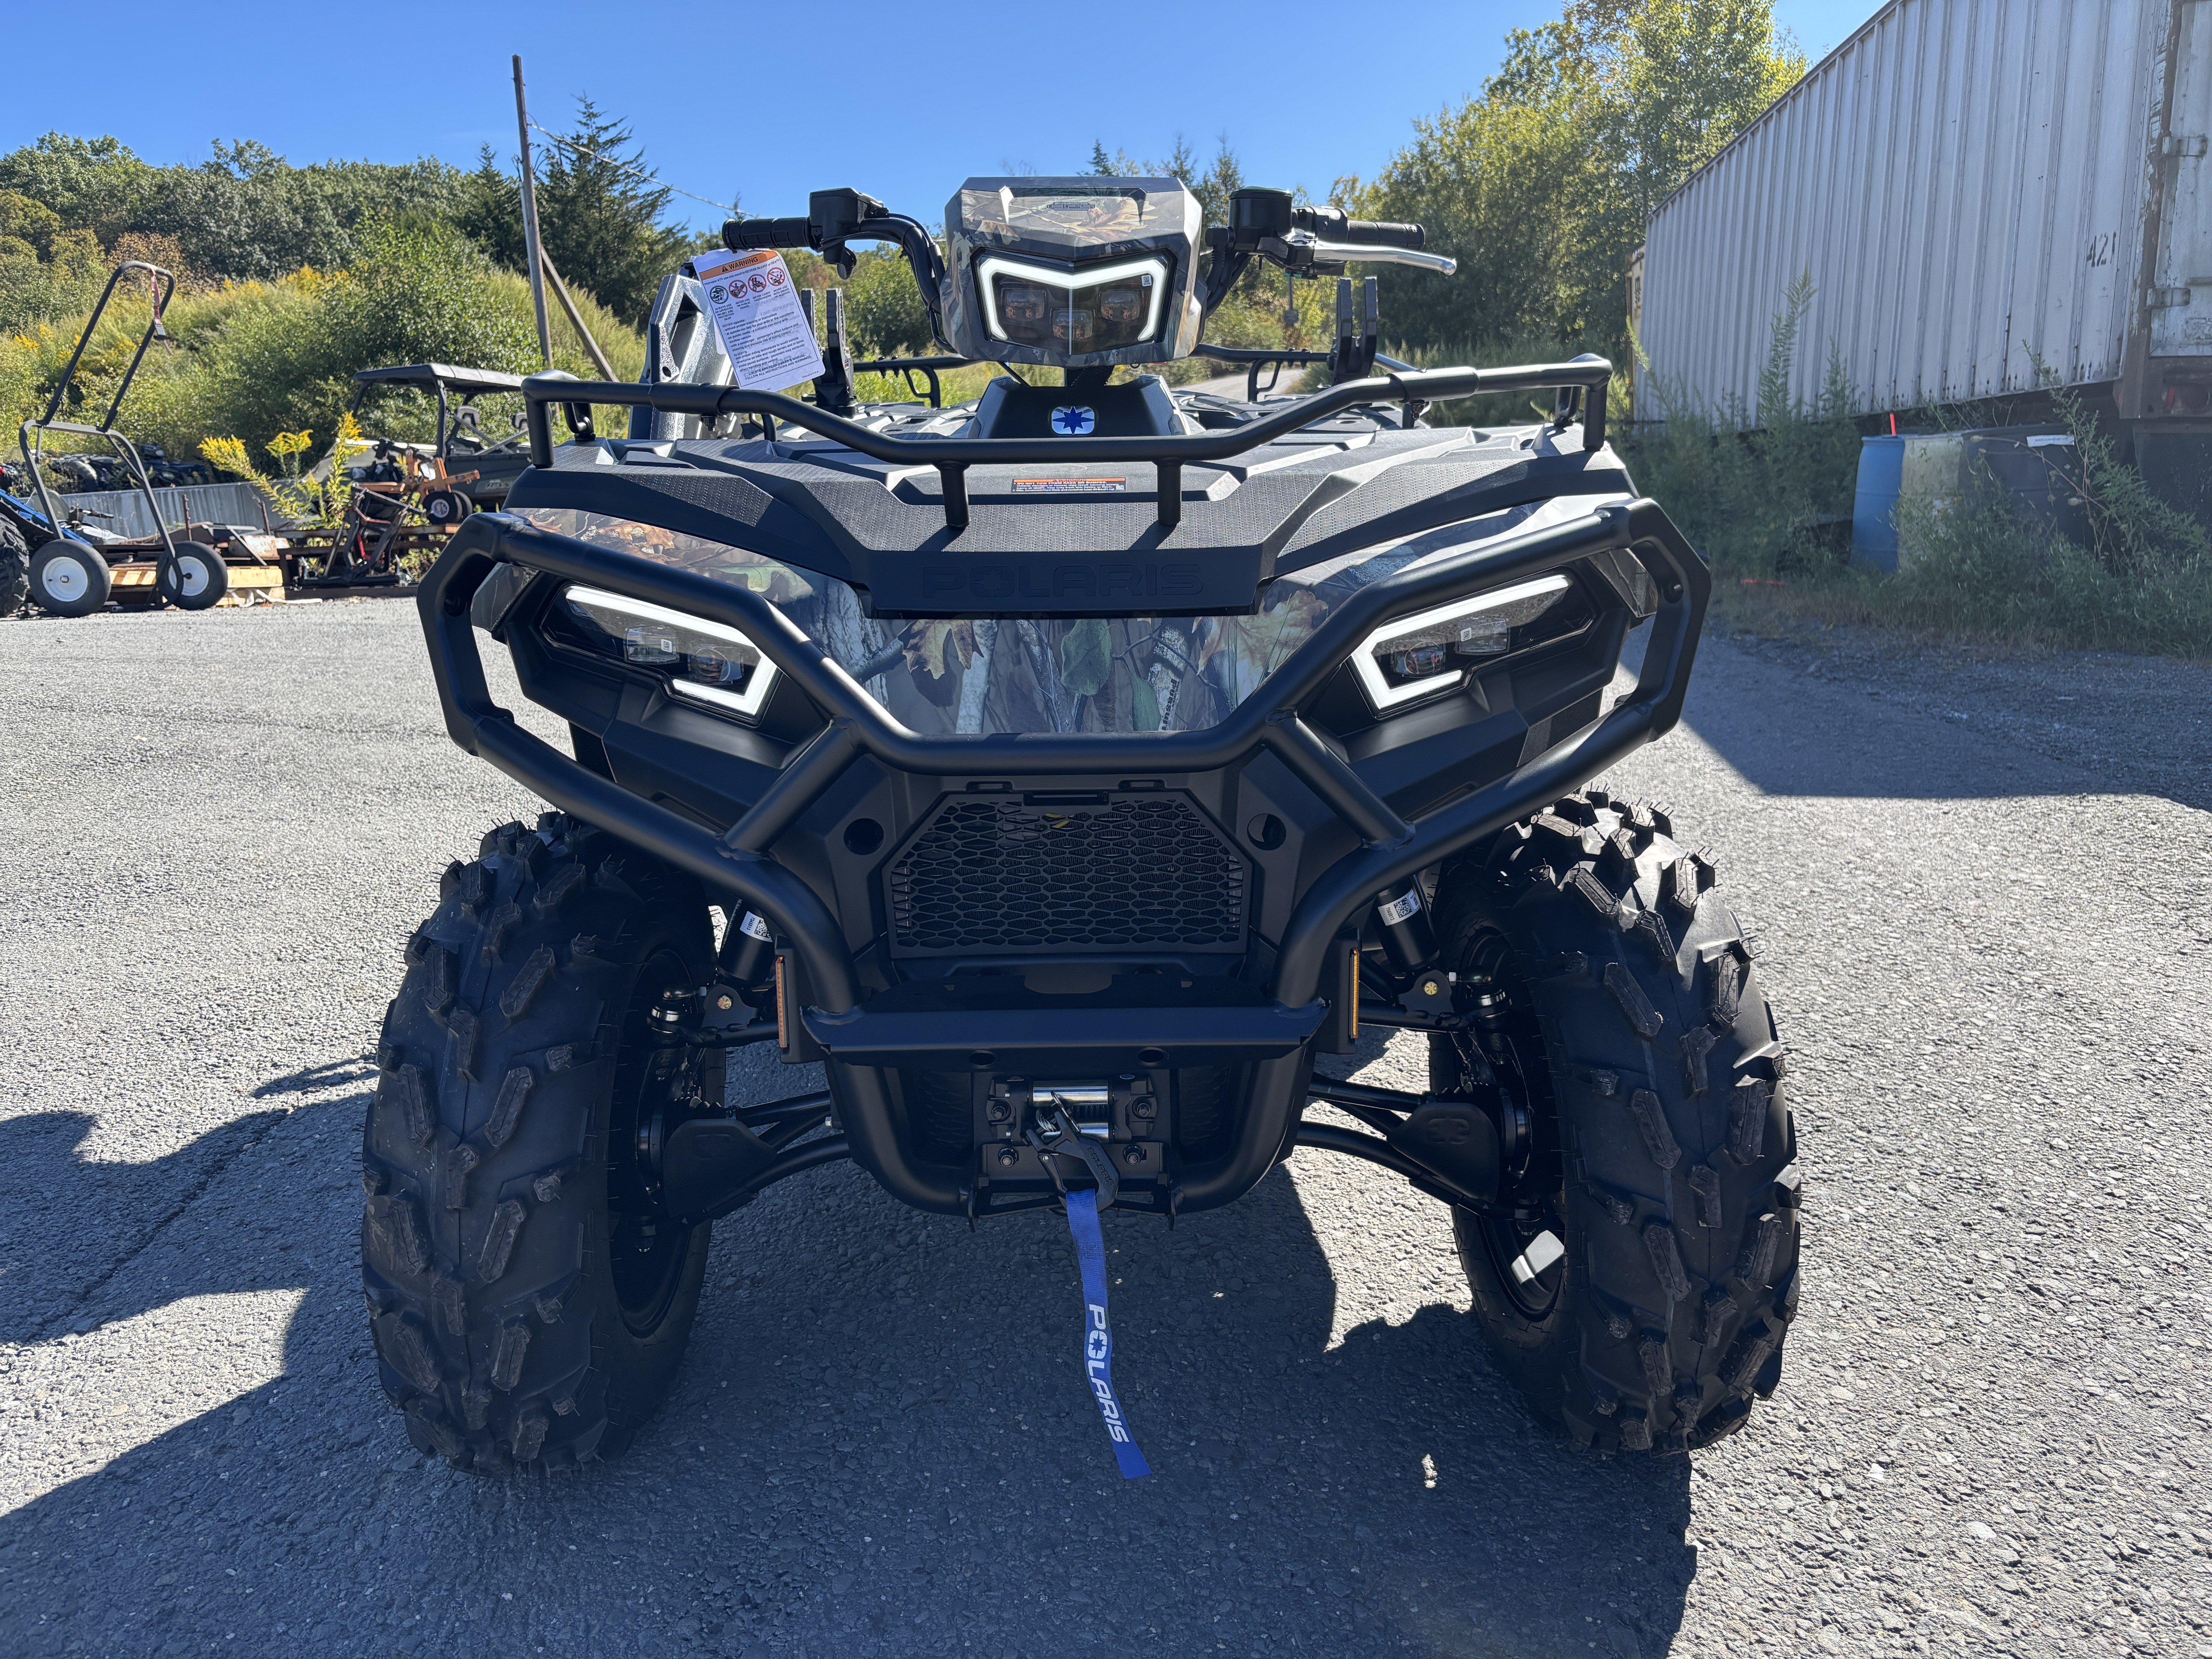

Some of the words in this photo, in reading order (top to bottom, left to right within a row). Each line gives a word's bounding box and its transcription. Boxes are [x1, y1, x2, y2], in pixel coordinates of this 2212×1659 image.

[729, 257, 758, 269] WARNING
[2086, 231, 2117, 268] 421
[922, 564, 1204, 598] POLARIS
[1086, 1146, 1115, 1187] POLARIS
[1087, 1304, 1130, 1443] POLARIS
